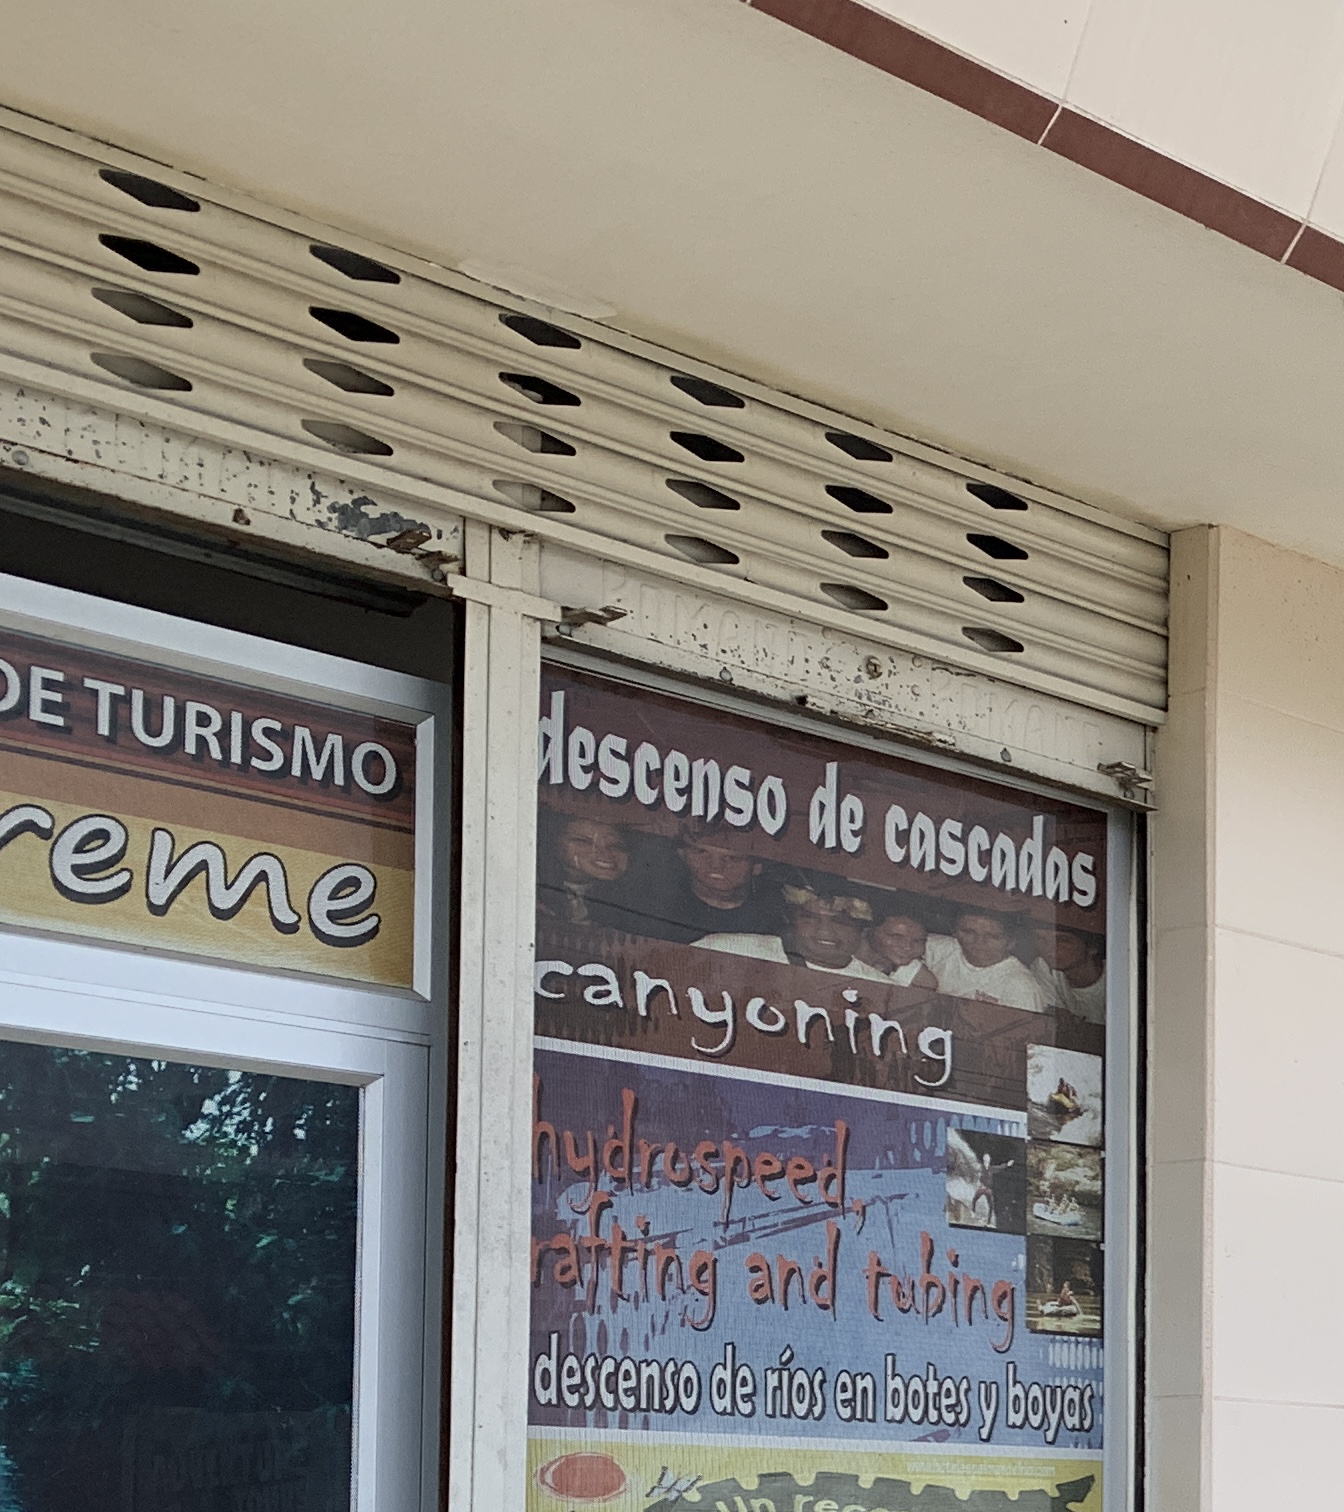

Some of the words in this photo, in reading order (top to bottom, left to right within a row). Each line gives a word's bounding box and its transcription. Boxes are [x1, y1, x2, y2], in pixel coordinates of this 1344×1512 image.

[83, 677, 396, 794] TURISMO
[536, 690, 787, 835] descenso
[809, 762, 864, 852] de
[885, 804, 1096, 907] cascadas
[533, 960, 953, 1086] canyoning
[530, 1190, 719, 1331] rafting
[745, 1219, 841, 1321] and
[863, 1231, 1015, 1353] tubing
[533, 1331, 701, 1414] descenso
[710, 1342, 756, 1417] de
[764, 1344, 827, 1421] ríos
[834, 1370, 876, 1423] en
[885, 1353, 971, 1427] botes
[978, 1381, 998, 1442] y
[1006, 1362, 1094, 1444] boyas
